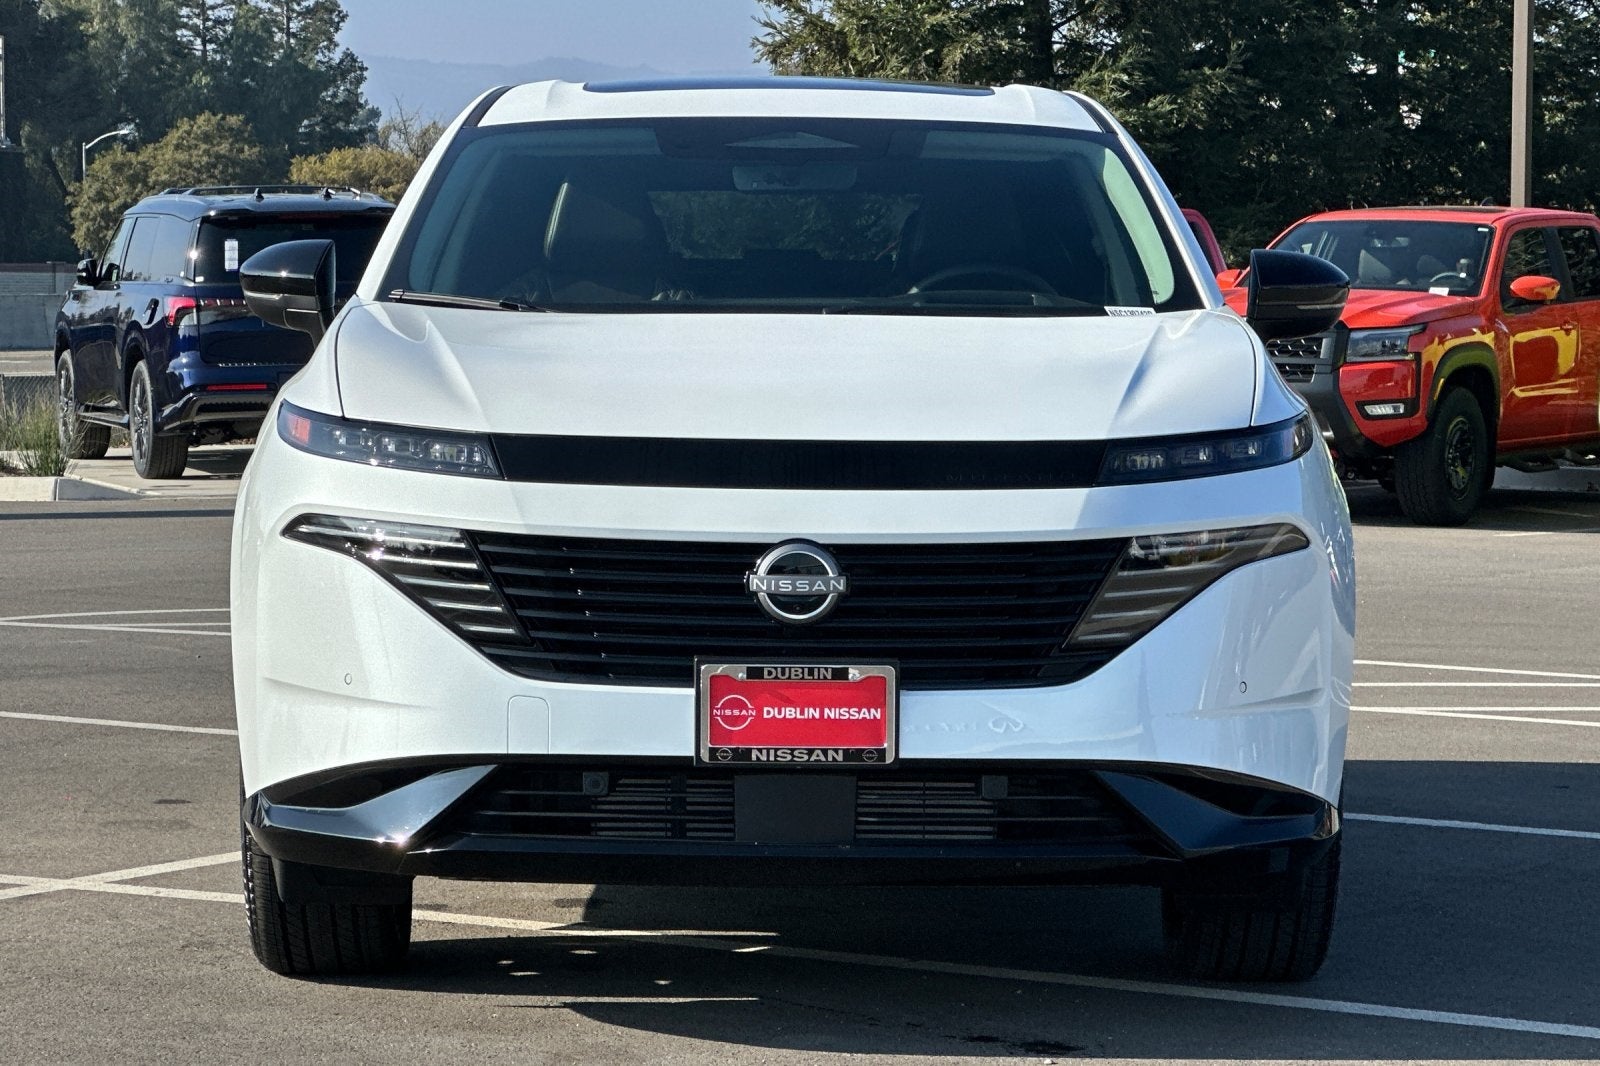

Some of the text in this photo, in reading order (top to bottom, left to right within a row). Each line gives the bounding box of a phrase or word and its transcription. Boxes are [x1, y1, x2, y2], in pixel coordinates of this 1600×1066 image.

[753, 578, 844, 591] NISSAN
[763, 667, 832, 680] DUBLIN
[763, 707, 881, 720] DUBLIN NISSAN
[751, 749, 844, 762] NISSAN
